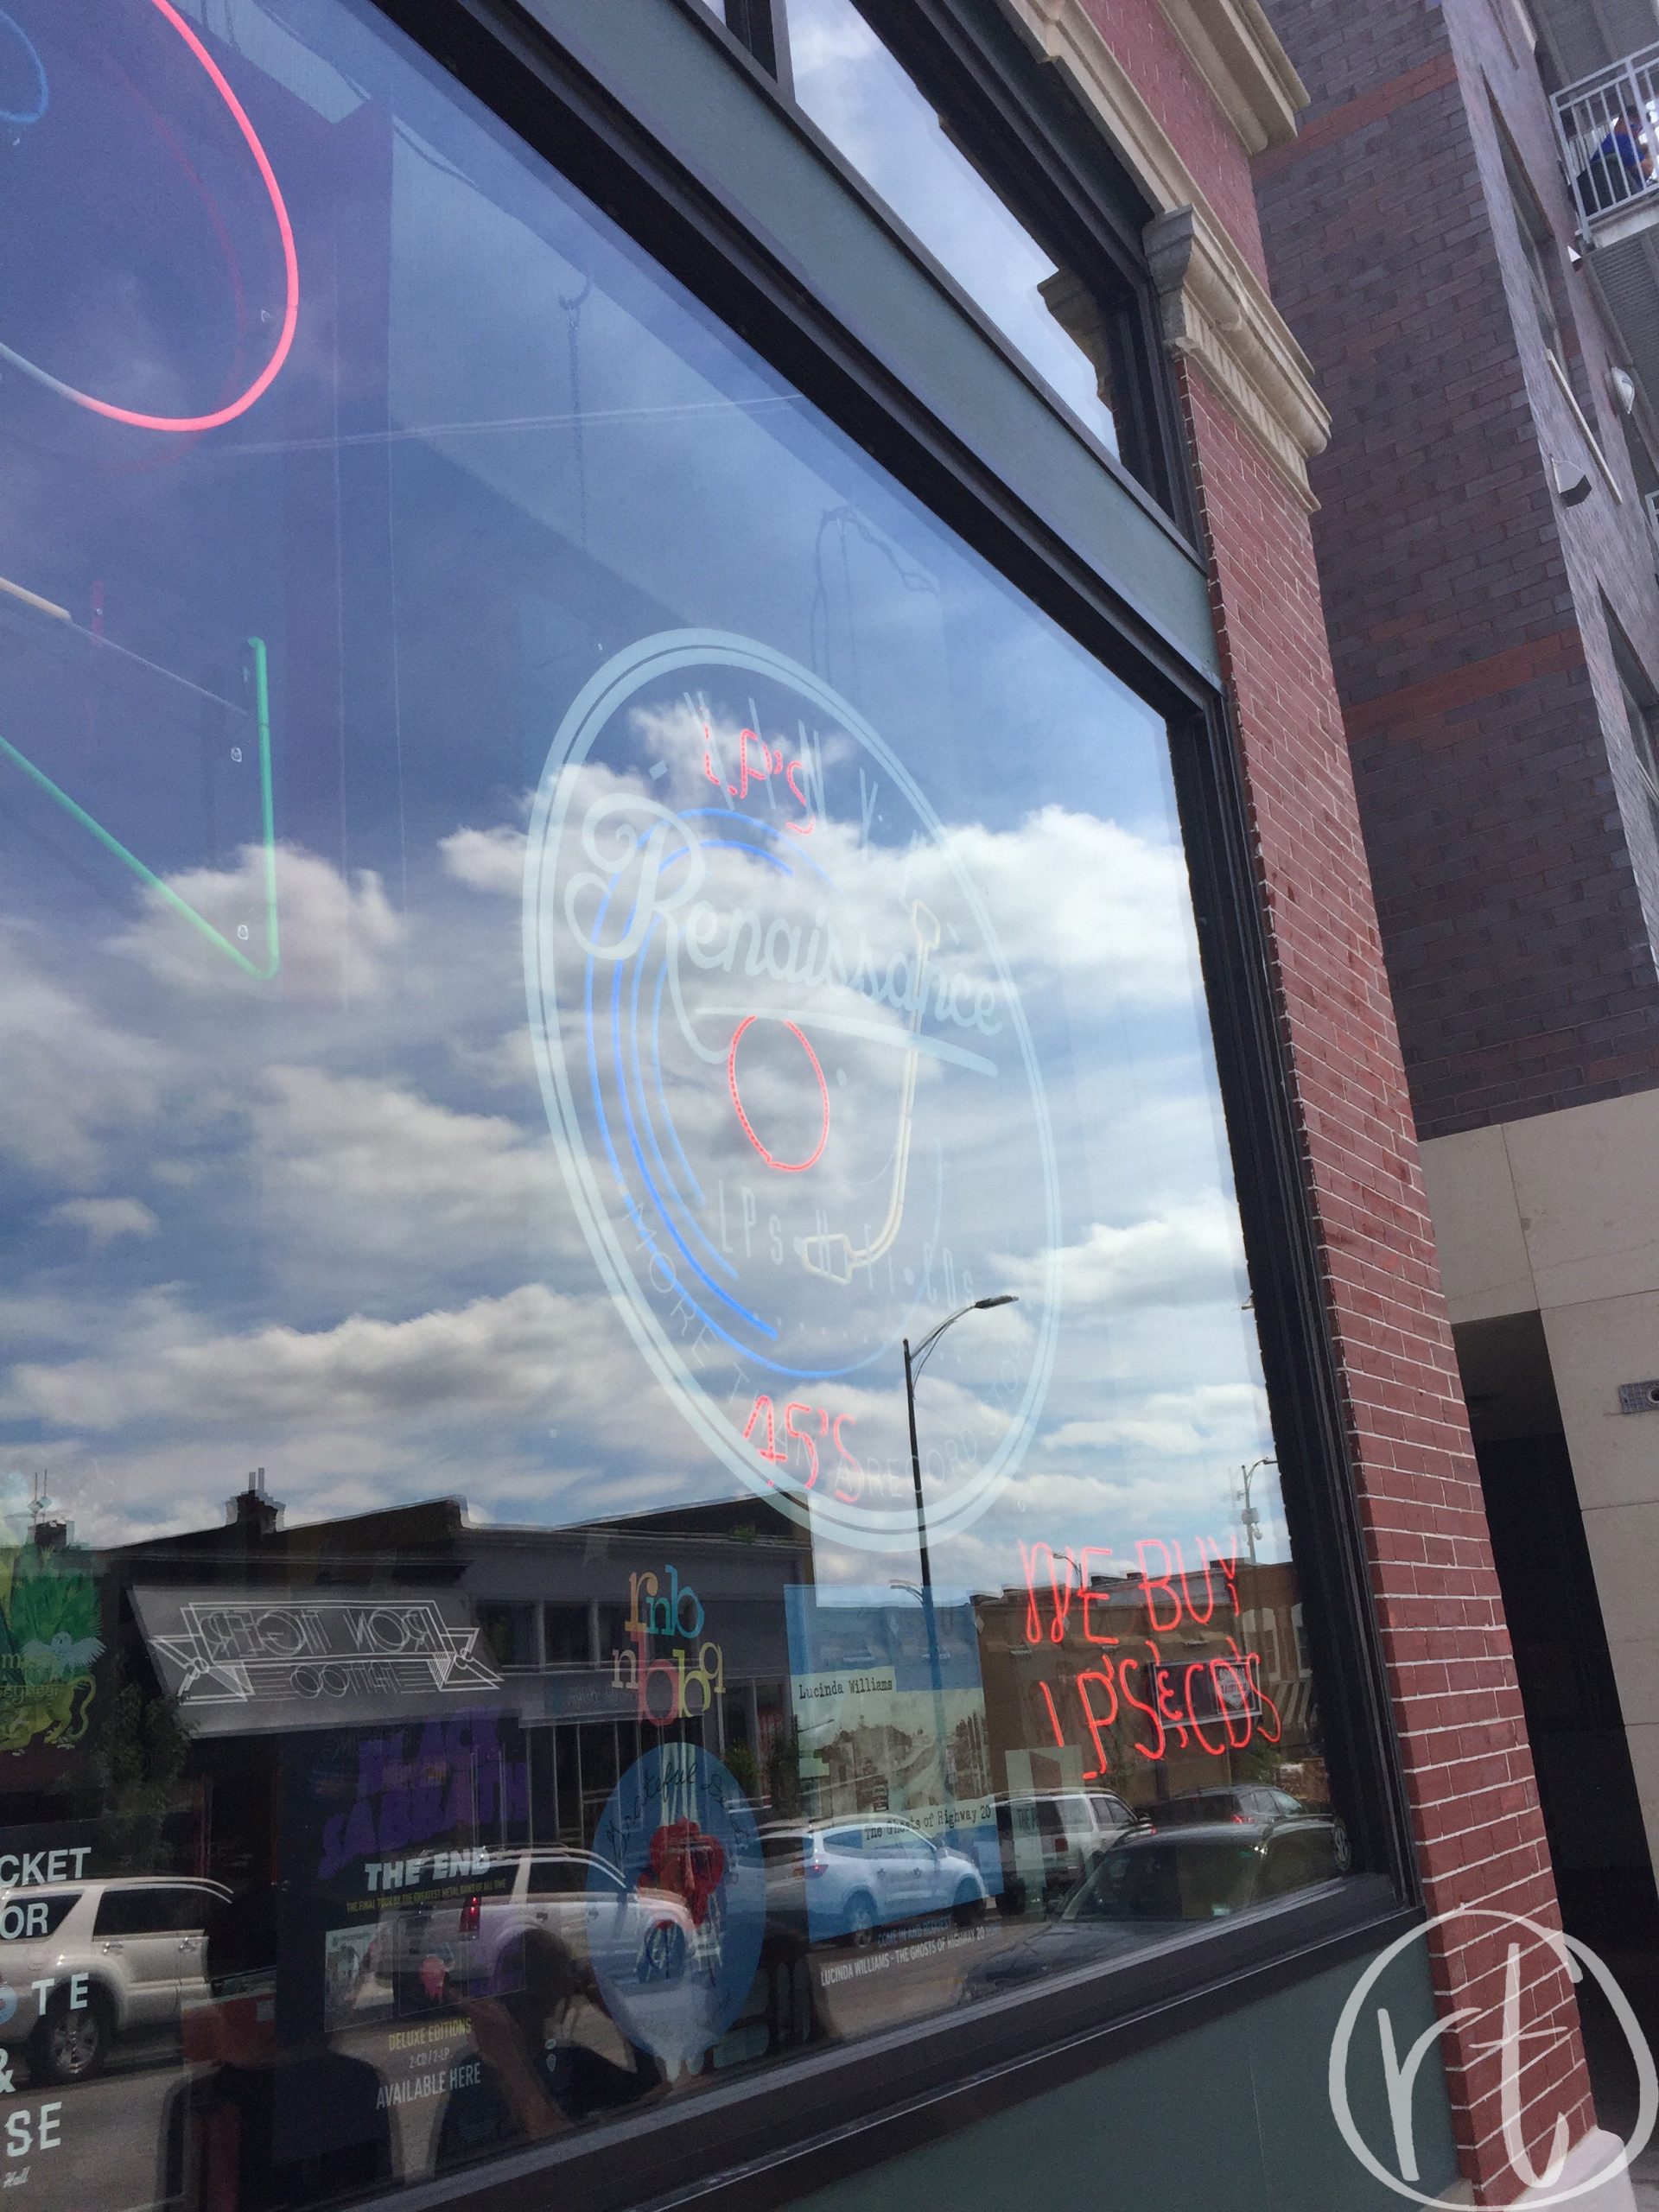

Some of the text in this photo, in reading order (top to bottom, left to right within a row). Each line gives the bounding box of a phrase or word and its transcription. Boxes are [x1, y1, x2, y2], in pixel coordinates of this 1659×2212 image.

[563, 792, 1002, 1061] Renaissance
[718, 1179, 785, 1265] LPs
[1017, 1535, 1241, 1644] WE BUY
[798, 1678, 893, 1700] Lucinda Williams
[924, 1811, 934, 1827] of
[938, 1806, 978, 1829] Highway
[981, 1805, 992, 1820] 20
[0, 1847, 92, 1887] CKET
[365, 1847, 491, 1891] THE END
[821, 1964, 855, 1986] LUCINDA
[854, 1953, 890, 1977] WILLIAMS
[895, 1948, 910, 1964] THE
[910, 1939, 937, 1961] GHOSTS
[938, 1936, 945, 1952] OF
[976, 1926, 985, 1942] 20
[389, 2017, 472, 2052] DELUXE EDITIONS
[376, 2062, 480, 2110] AVAILABLE HERE
